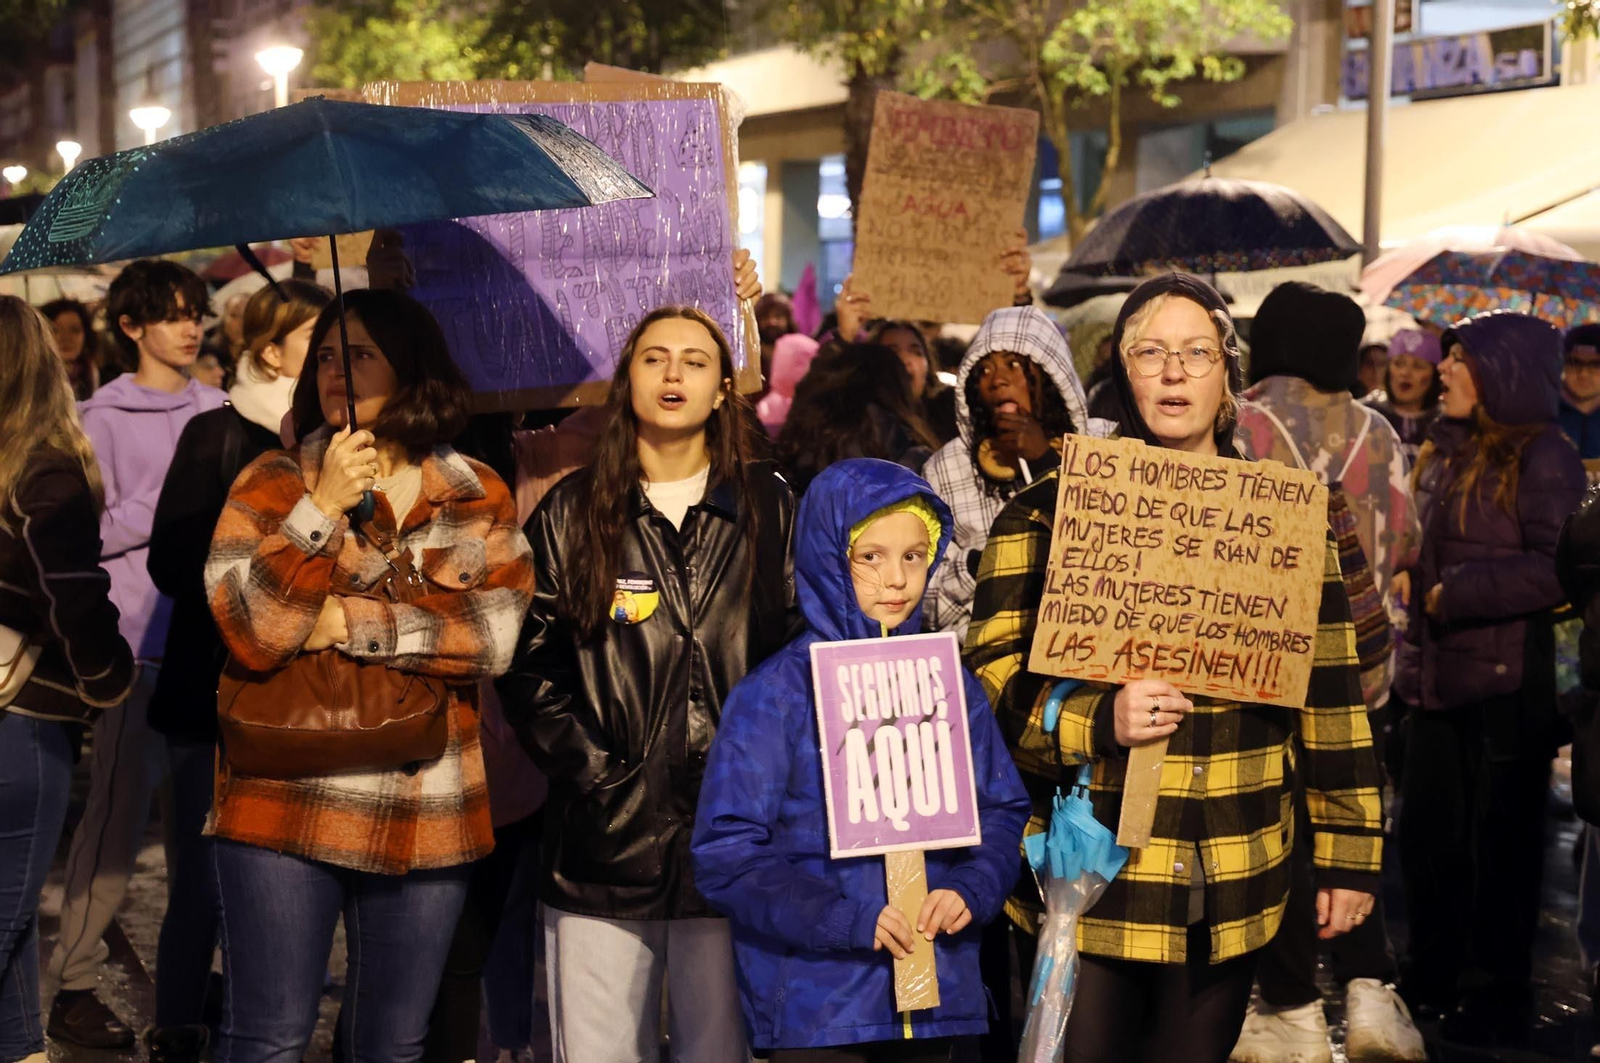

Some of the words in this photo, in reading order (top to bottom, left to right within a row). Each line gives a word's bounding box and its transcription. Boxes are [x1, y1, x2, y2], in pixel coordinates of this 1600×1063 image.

[1130, 457, 1228, 492] HOMBRES
[1238, 471, 1315, 505] TIENEN
[1063, 481, 1127, 515] MIEDO
[1134, 498, 1168, 520] DE
[1170, 502, 1222, 528] QUE
[1225, 507, 1274, 538] LAS
[1058, 514, 1163, 553] MUJERES
[1172, 534, 1203, 558] SE
[1271, 546, 1302, 569] DE
[1093, 576, 1195, 610] MUJERES
[1200, 589, 1288, 618] TIENEN
[1042, 599, 1108, 626] MIEDO
[1114, 608, 1144, 630] DE
[1148, 612, 1197, 638] QUE
[1197, 618, 1229, 639] LOS
[1234, 627, 1313, 654] HOMBRES
[1046, 630, 1095, 662] LAS
[1113, 636, 1282, 688] ASESINEN!!!
[837, 656, 946, 723] SEGUIMOS
[845, 699, 958, 832] AQUÍ
